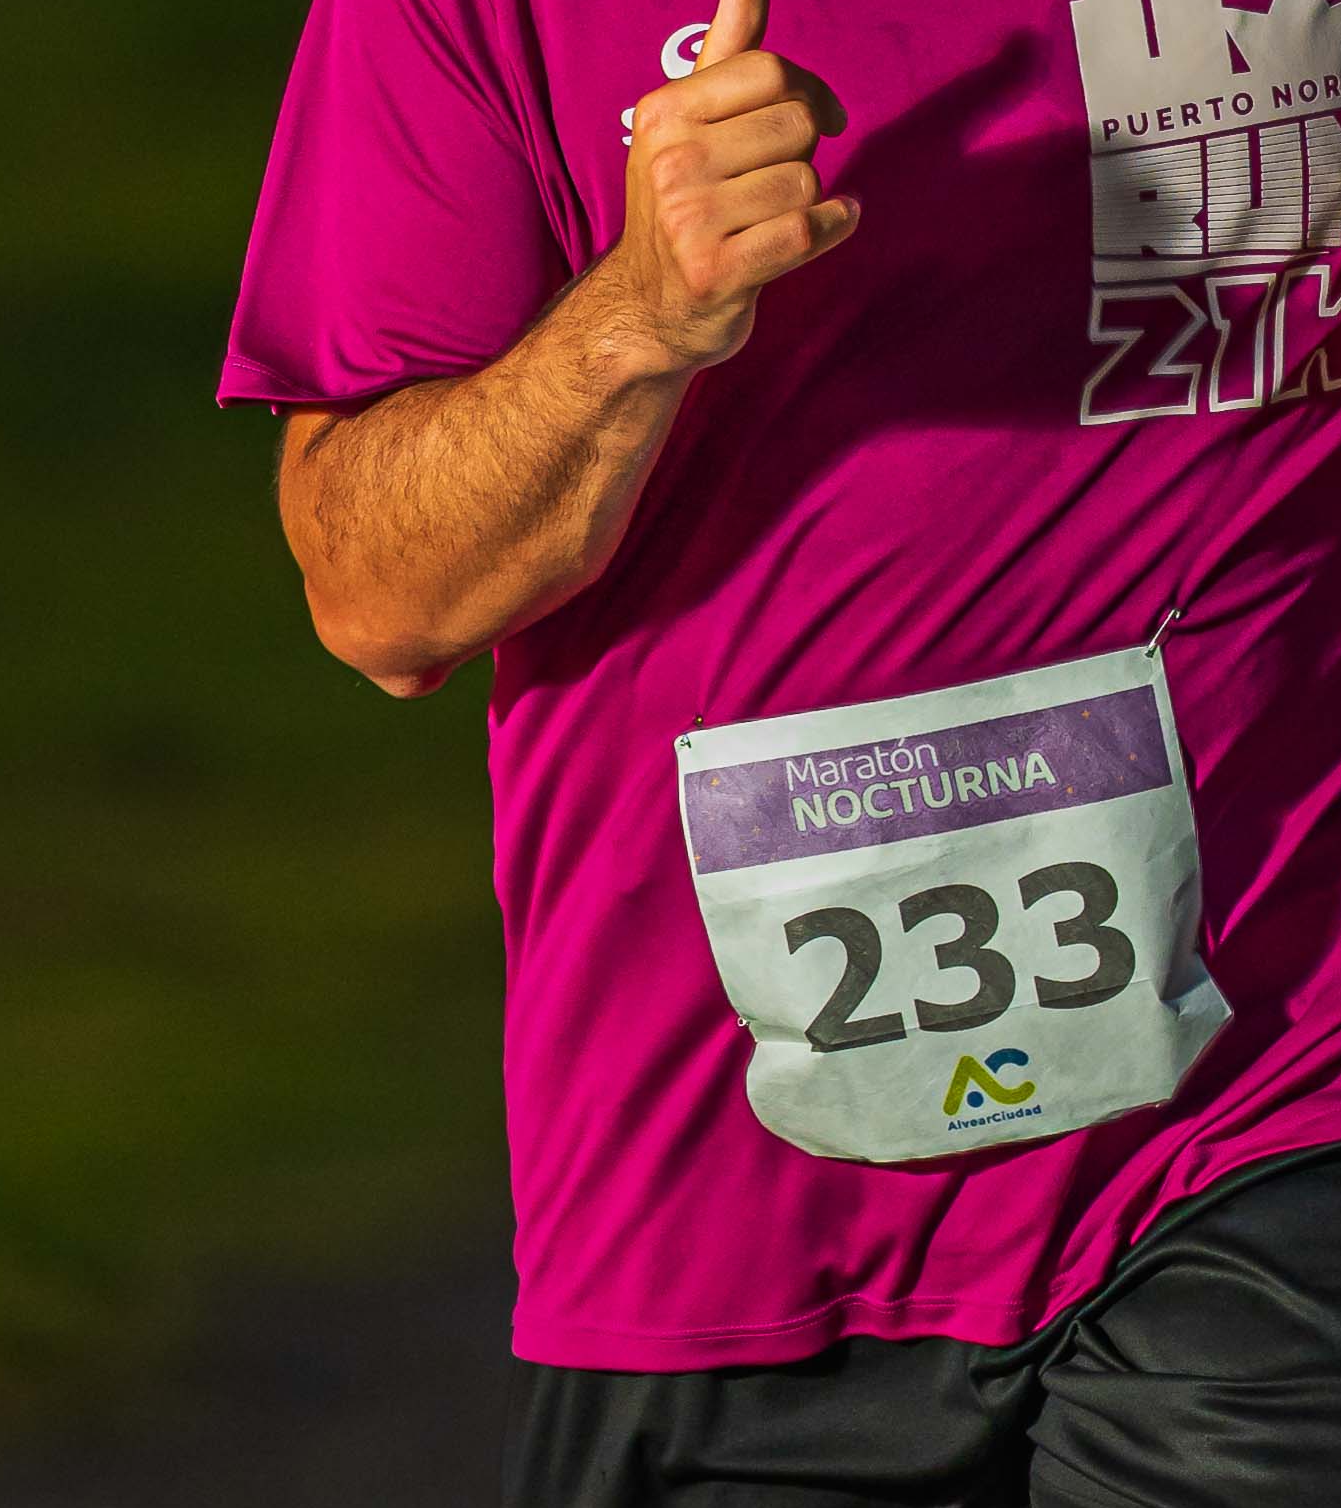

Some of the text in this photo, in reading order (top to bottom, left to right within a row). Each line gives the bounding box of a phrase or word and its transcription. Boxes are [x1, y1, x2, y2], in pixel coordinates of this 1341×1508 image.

[1101, 92, 1254, 142] PUERTO
[785, 738, 939, 791] Maratón
[791, 751, 1057, 832] NOCTURNA
[783, 861, 1136, 1053] 233
[947, 1104, 1043, 1132] AlvearCiudad
